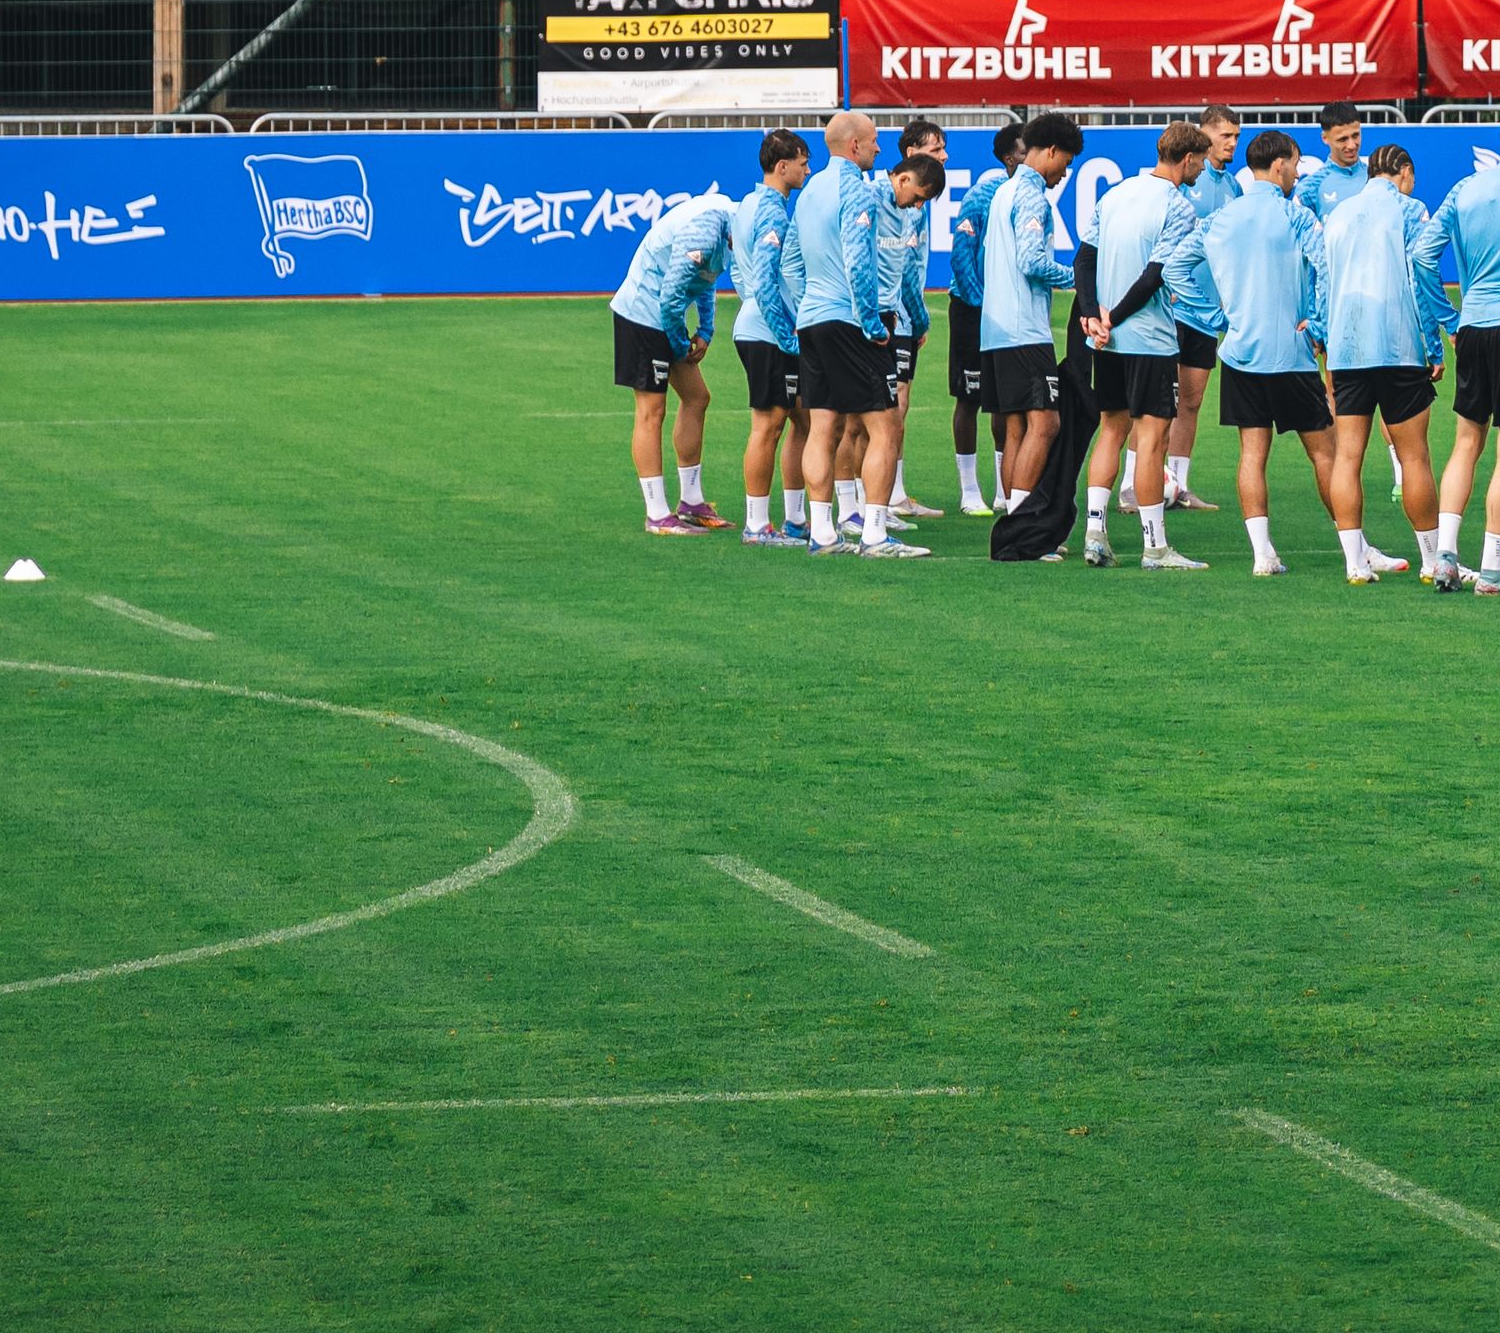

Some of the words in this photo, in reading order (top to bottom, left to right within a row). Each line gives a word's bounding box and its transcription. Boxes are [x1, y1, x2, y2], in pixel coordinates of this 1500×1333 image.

[604, 21, 640, 37] +43
[647, 20, 683, 36] 676
[690, 18, 774, 34] 4603027
[583, 46, 646, 60] GOOD
[660, 44, 724, 59] VIBES
[738, 43, 793, 58] ONLY
